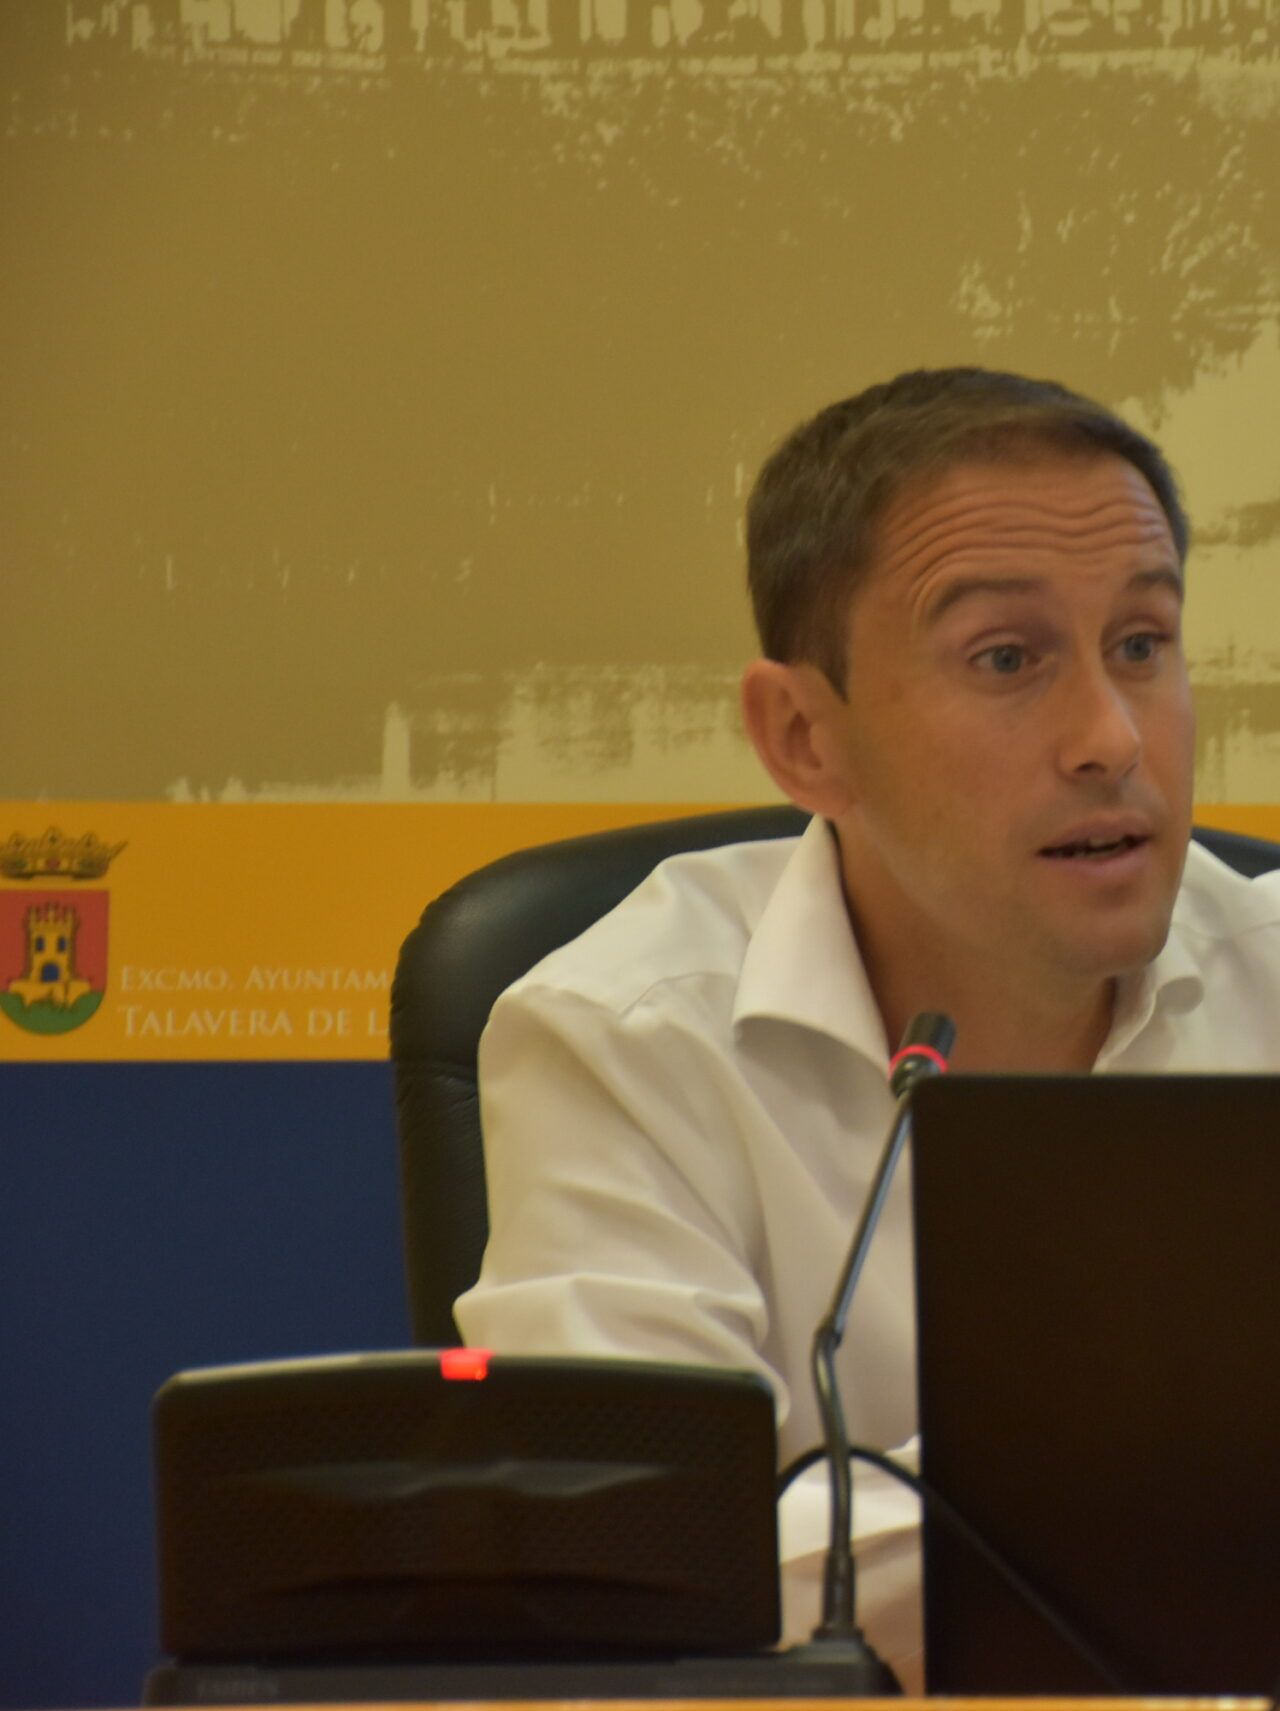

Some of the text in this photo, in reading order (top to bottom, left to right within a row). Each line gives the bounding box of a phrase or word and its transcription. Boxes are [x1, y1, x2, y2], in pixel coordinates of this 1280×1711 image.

[120, 964, 389, 993] EXCMO. AYUNTAM
[118, 1004, 389, 1038] TALAVERA DE L
